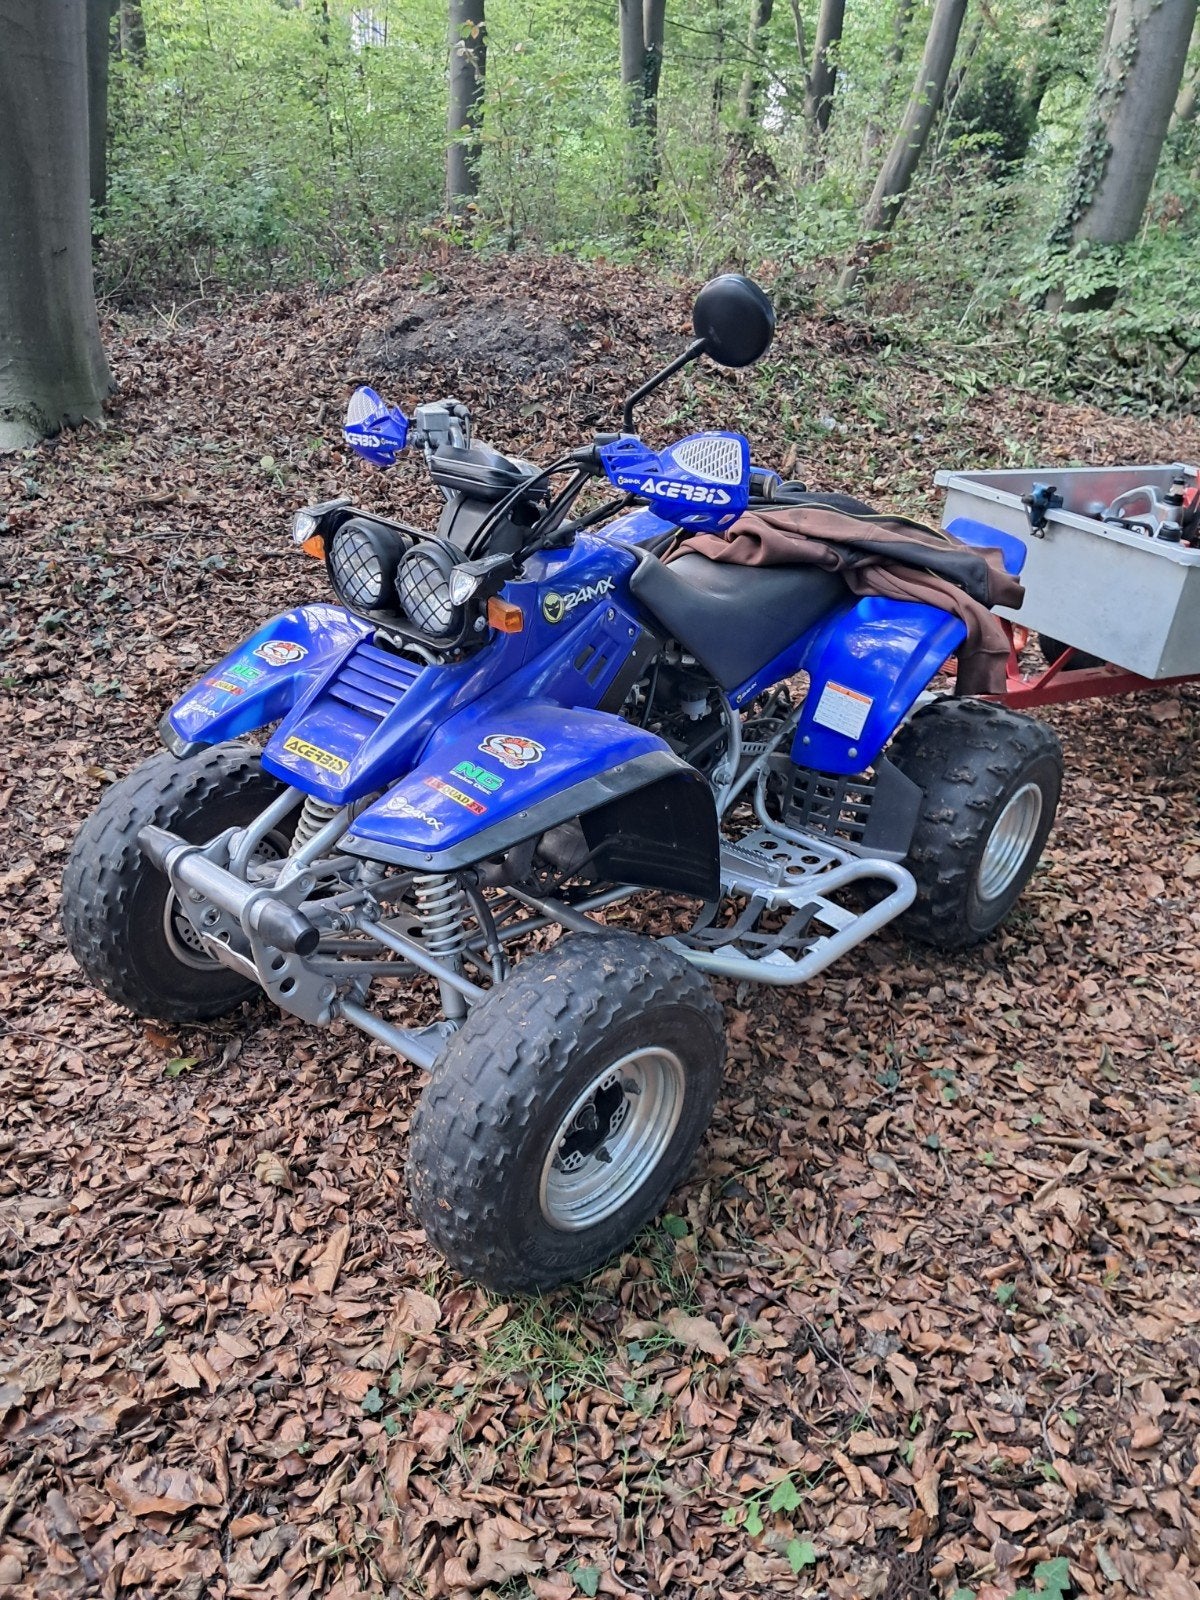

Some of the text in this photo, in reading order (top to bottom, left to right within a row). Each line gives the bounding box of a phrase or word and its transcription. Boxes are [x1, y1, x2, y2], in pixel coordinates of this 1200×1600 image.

[640, 478, 731, 505] ACERBIS
[563, 576, 616, 610] 24MX
[287, 739, 345, 773] ACERBIS
[453, 761, 504, 791] NG
[402, 804, 446, 831] 24MX
